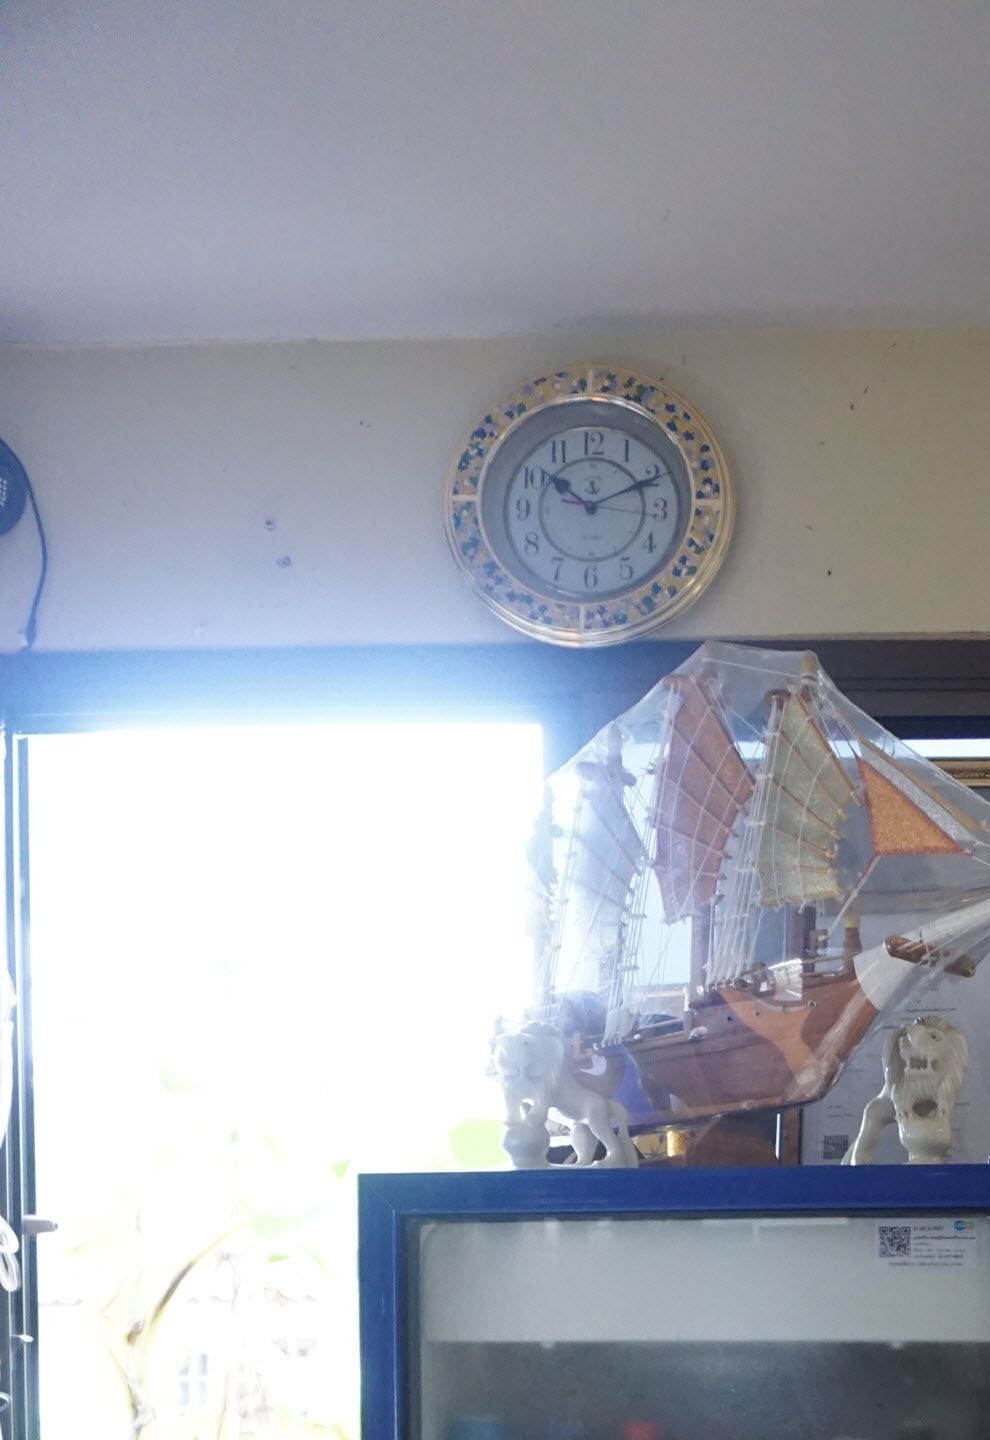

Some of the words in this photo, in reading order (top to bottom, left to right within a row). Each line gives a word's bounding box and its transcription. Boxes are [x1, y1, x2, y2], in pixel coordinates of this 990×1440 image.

[551, 440, 567, 463] 11
[583, 431, 605, 456] 12
[623, 439, 630, 462] 1
[523, 465, 546, 489] 10
[516, 498, 530, 521] 9
[653, 499, 668, 521] 3
[524, 532, 539, 555] 8
[641, 531, 656, 554] 4
[551, 557, 565, 581] 7
[584, 565, 598, 588] 6
[619, 557, 634, 580] 5
